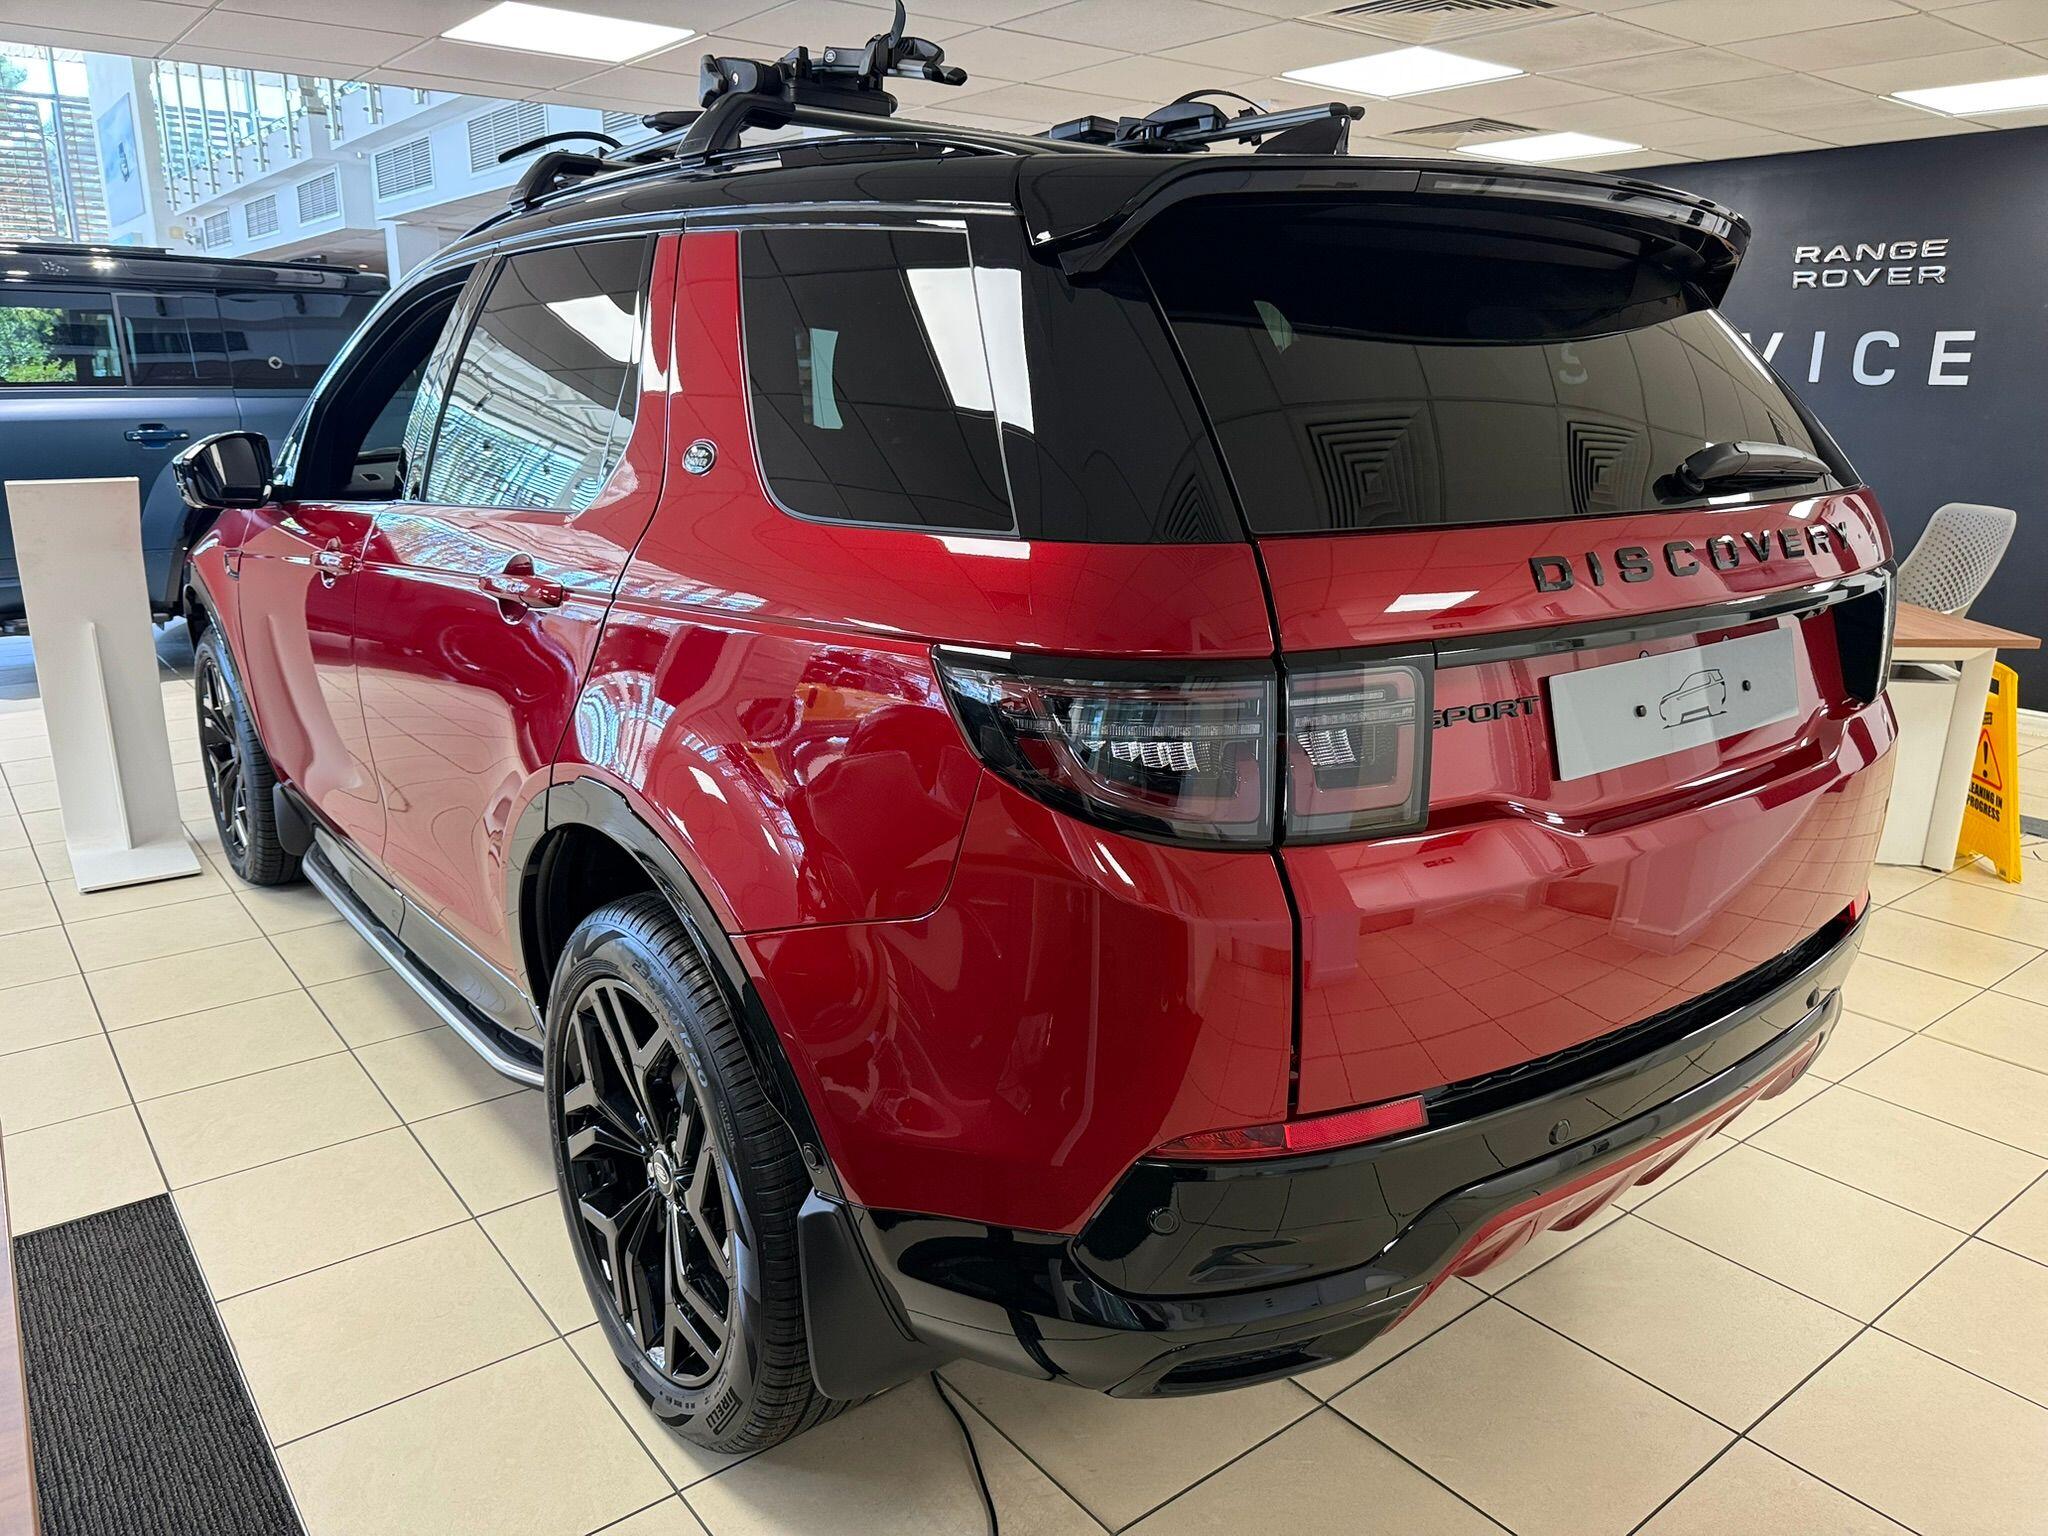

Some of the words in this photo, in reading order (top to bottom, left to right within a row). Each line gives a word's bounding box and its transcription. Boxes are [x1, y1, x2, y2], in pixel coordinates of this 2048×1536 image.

[1793, 238, 1950, 264] RANGE
[1792, 265, 1947, 290] ROVER
[1528, 521, 1850, 593] DISCOVERY
[705, 1385, 743, 1435] PIRELLI
